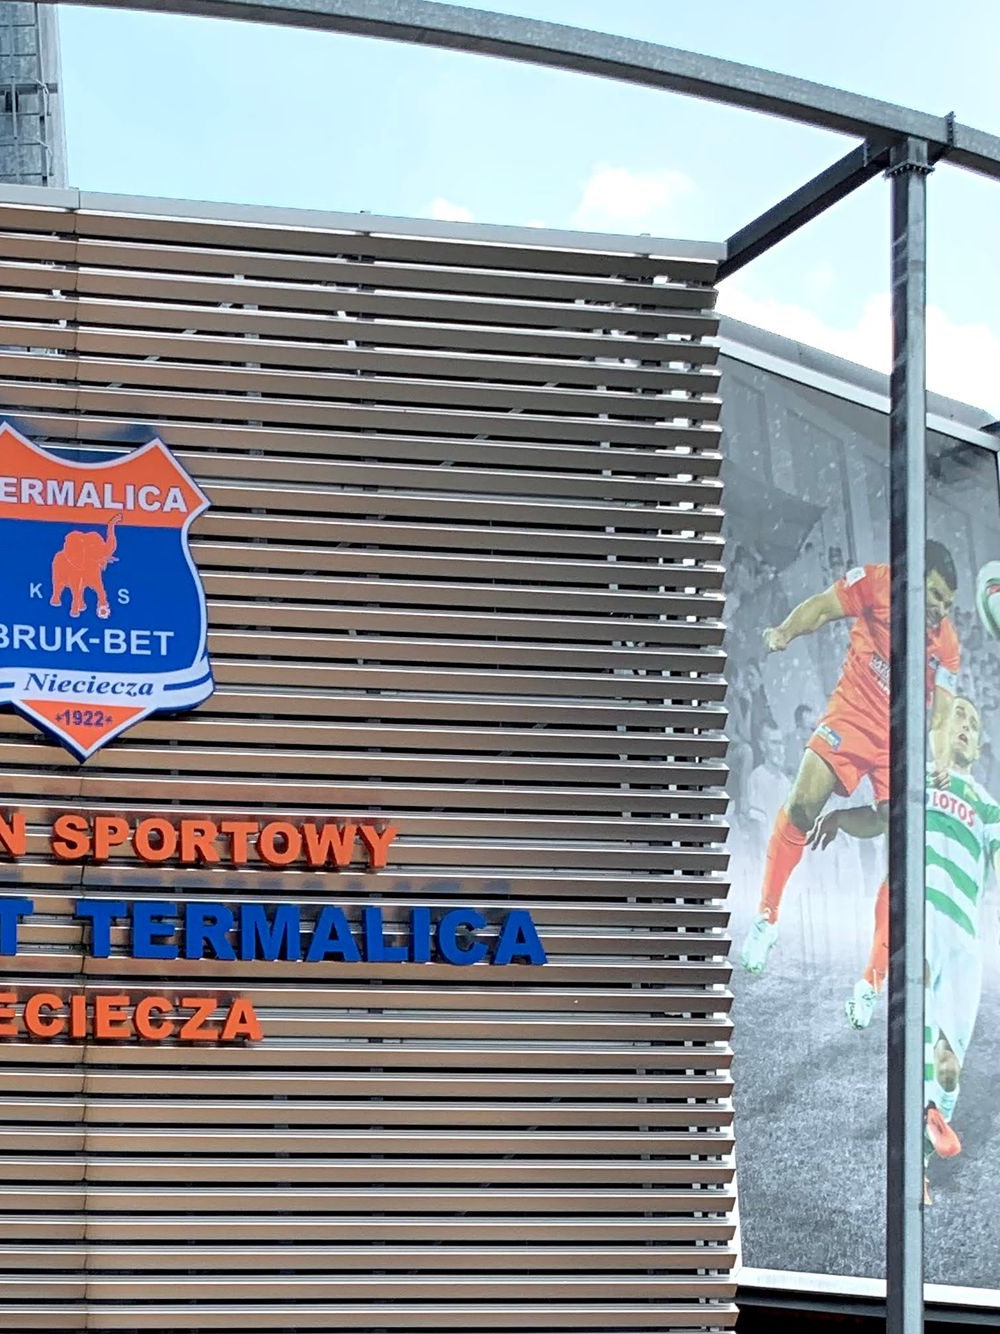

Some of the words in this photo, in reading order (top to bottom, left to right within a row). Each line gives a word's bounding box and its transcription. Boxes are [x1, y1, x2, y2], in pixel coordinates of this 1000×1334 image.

[29, 582, 43, 599] K
[117, 588, 130, 605] S
[22, 672, 156, 698] Nieciecza
[62, 709, 105, 728] 1922
[932, 791, 976, 828] LOTOS
[51, 815, 399, 871] SPORTOWY
[76, 899, 549, 968] TERMALICA
